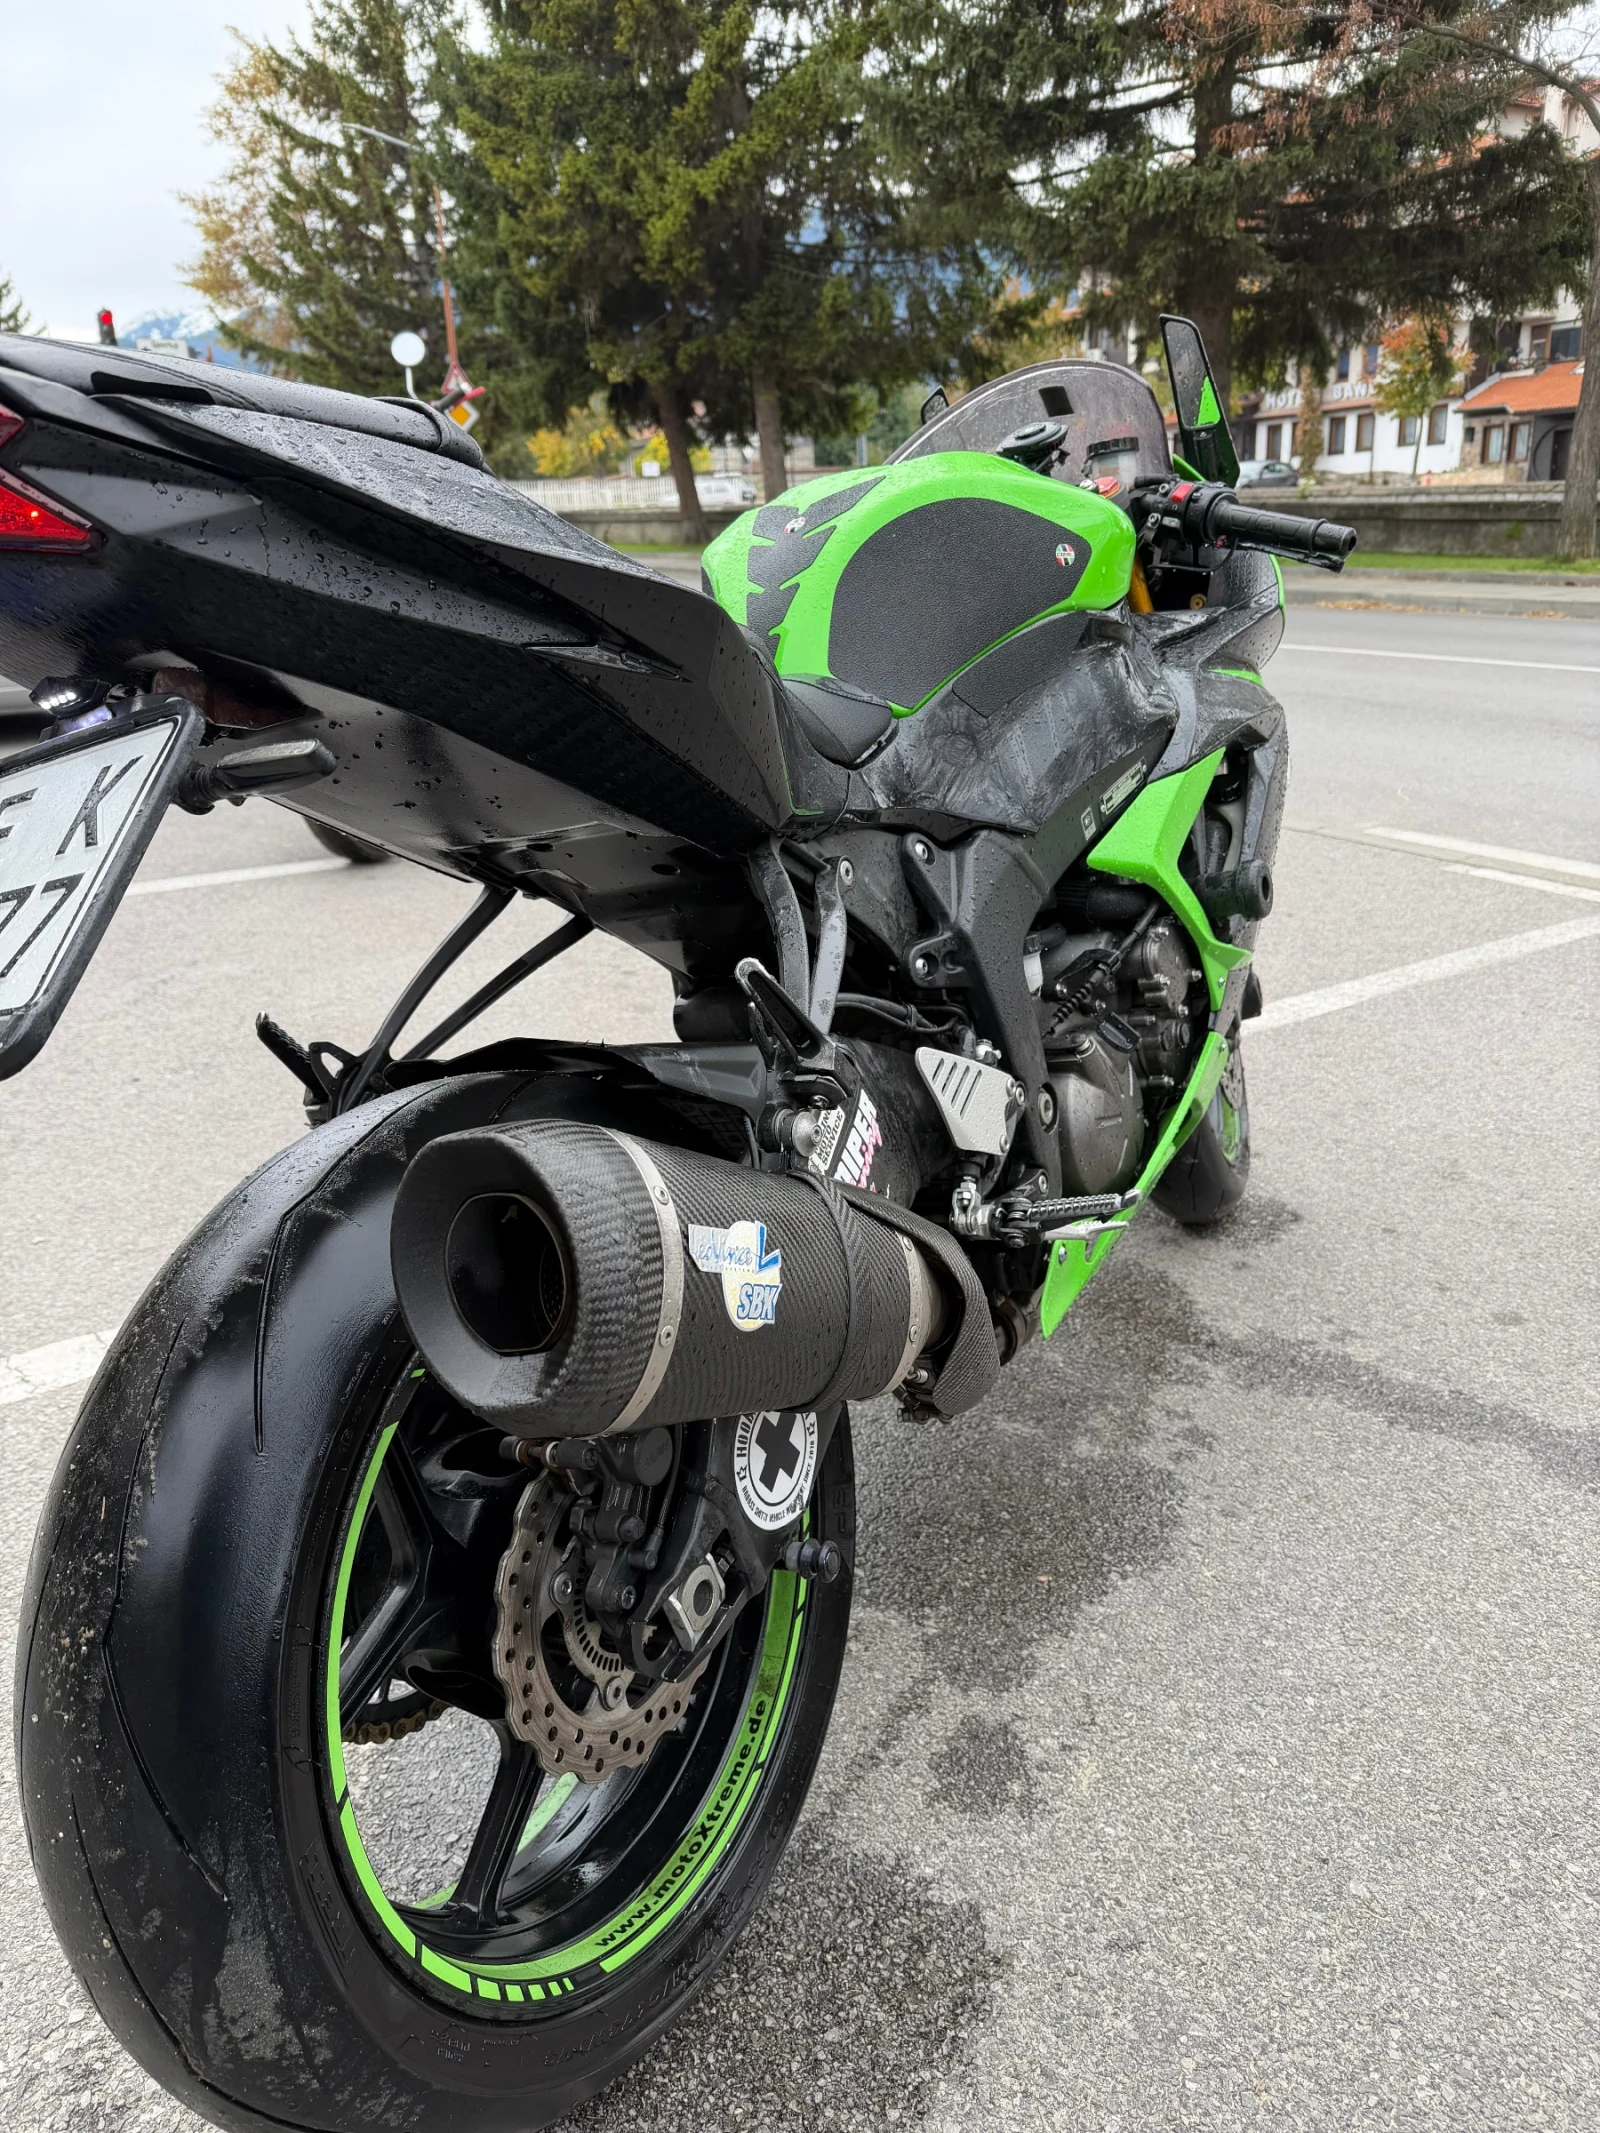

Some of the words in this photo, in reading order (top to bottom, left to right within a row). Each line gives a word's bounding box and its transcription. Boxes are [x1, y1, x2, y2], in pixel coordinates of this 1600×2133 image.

[815, 1124, 832, 1160] MOTO
[821, 1110, 843, 1166] SERVICE
[736, 1282, 780, 1320] SBK
[595, 1699, 766, 1947] www.motoXtreme.de
